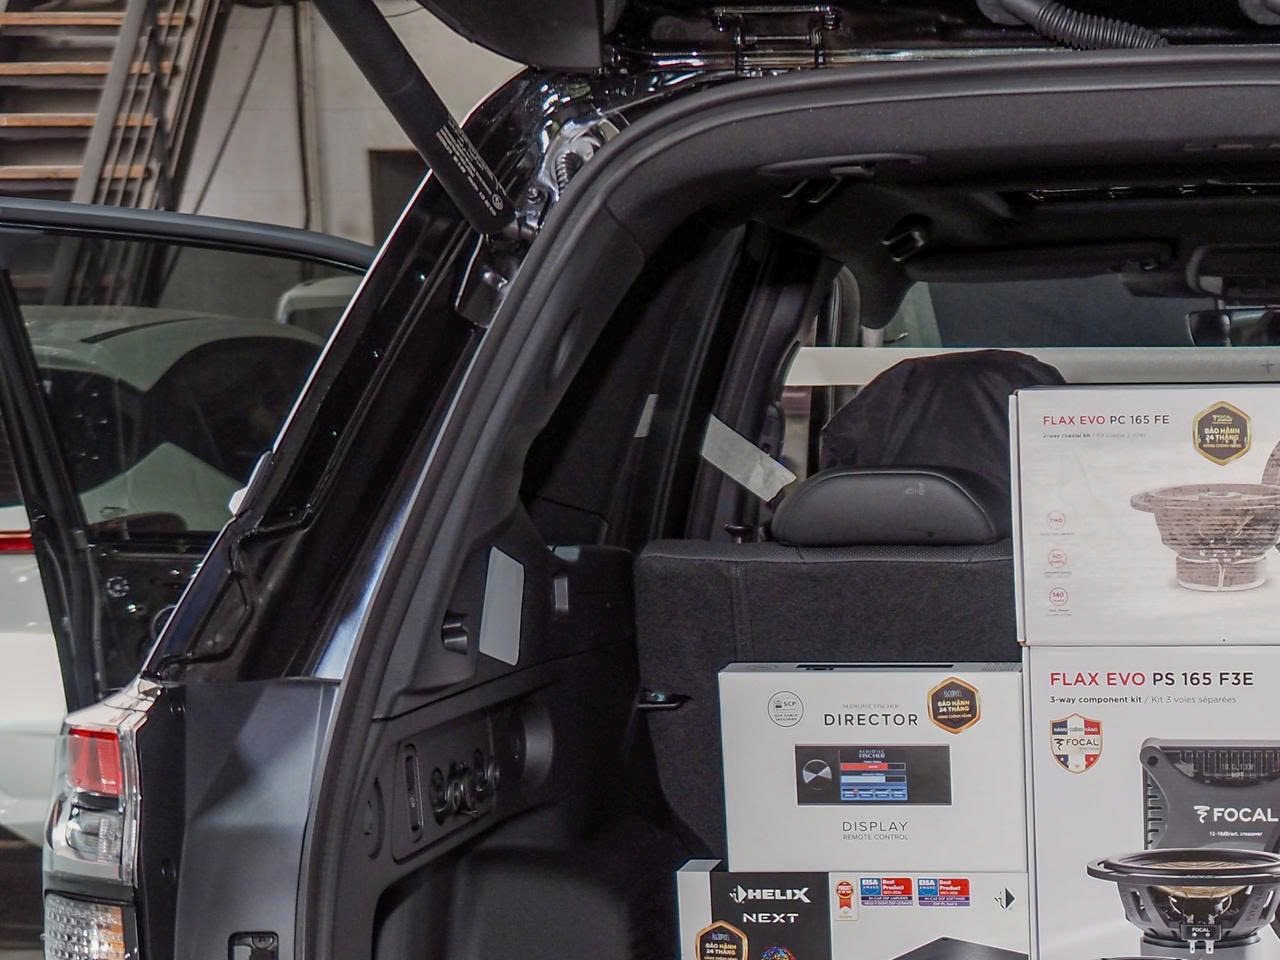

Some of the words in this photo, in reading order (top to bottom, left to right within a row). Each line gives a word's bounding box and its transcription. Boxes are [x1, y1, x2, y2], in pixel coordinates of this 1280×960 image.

[1043, 416, 1075, 425] FLAX
[1080, 416, 1105, 425] EVO
[1110, 415, 1126, 424] PC
[1130, 415, 1150, 424] 165
[1154, 415, 1170, 424] FE
[1050, 672, 1100, 686] FLAX
[1106, 672, 1146, 686] EVO
[1152, 672, 1175, 686] PS
[1181, 672, 1212, 686] 165
[1219, 672, 1254, 686] F3E
[1050, 695, 1076, 704] 3-way
[1079, 696, 1128, 704] component
[1131, 695, 1143, 703] kit
[1151, 695, 1164, 703] Kit
[823, 713, 919, 726] DIRECTOR
[1066, 738, 1099, 746] FOCAL
[1213, 807, 1279, 822] FOCAL
[842, 821, 909, 832] DISPLAY
[747, 887, 812, 903] HELIX
[743, 913, 799, 923] NEXT
